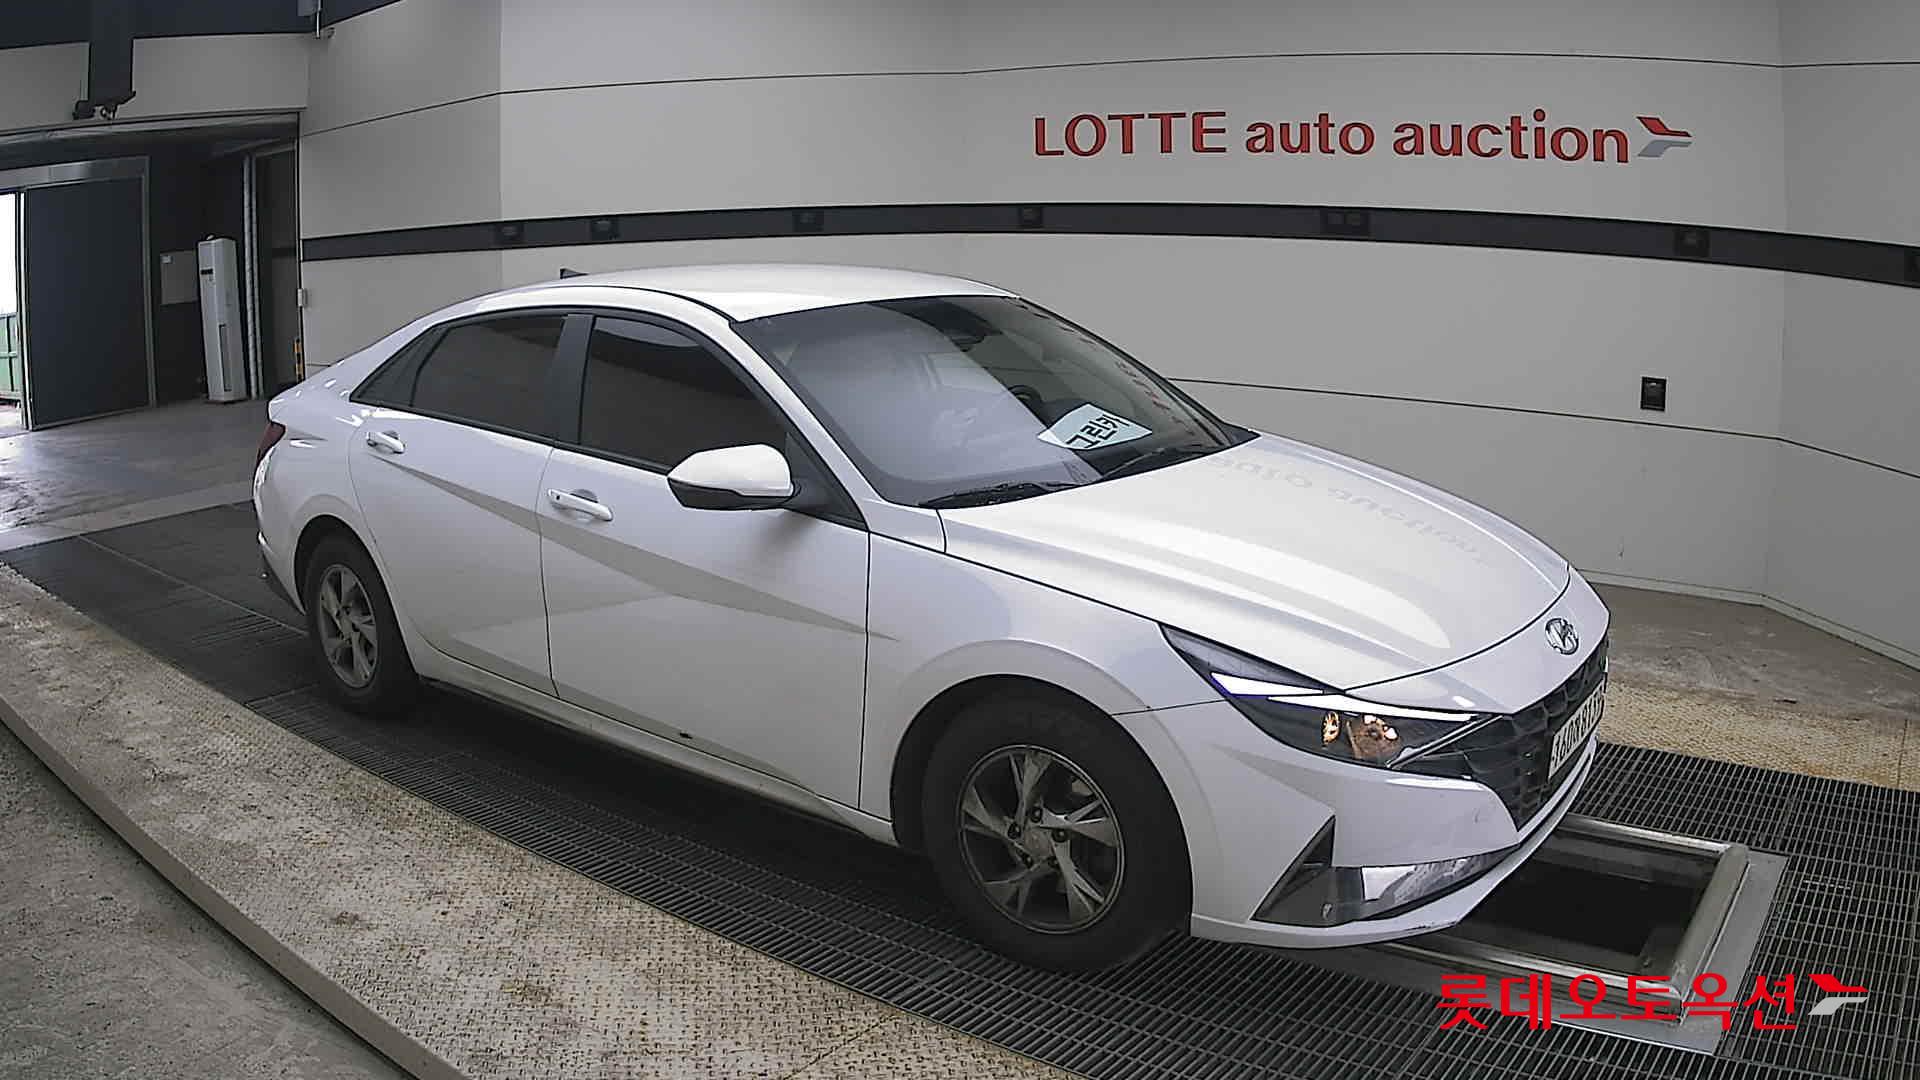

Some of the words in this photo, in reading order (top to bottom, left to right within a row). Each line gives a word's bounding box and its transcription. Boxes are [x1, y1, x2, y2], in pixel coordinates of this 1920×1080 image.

[1034, 111, 1227, 156] LOTTE
[1245, 112, 1375, 154] auto
[1393, 109, 1630, 163] auction
